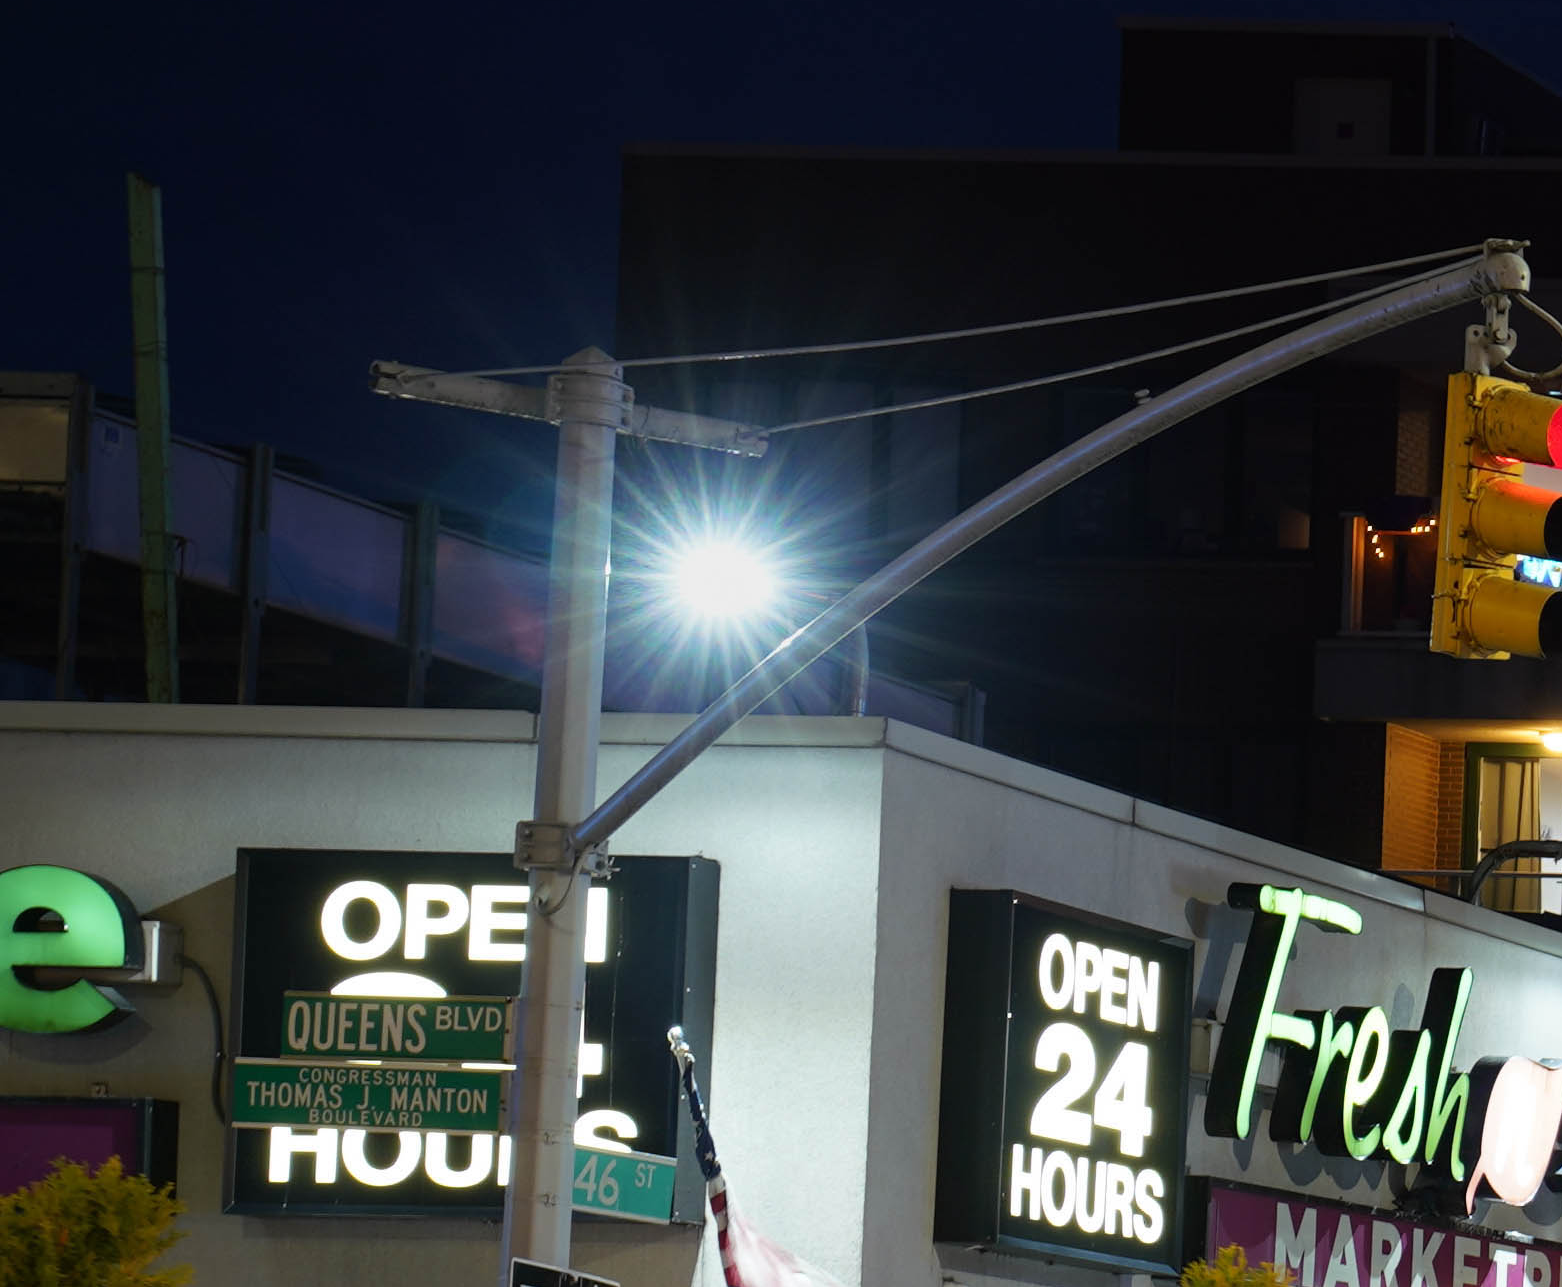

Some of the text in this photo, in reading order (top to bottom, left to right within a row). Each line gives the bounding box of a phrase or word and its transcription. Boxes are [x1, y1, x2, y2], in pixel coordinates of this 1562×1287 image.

[1038, 932, 1160, 1032] OPEN
[287, 1000, 502, 1054] QUEENS BLVD
[1234, 883, 1474, 1183] Fresh
[247, 1080, 488, 1114] THOMAS J. MANTON
[299, 1067, 437, 1086] CONGRESSMAN
[1030, 1022, 1155, 1158] 24
[309, 1109, 423, 1127] BOULEVARD
[574, 1154, 657, 1206] 46 ST
[1008, 1143, 1166, 1245] HOURS
